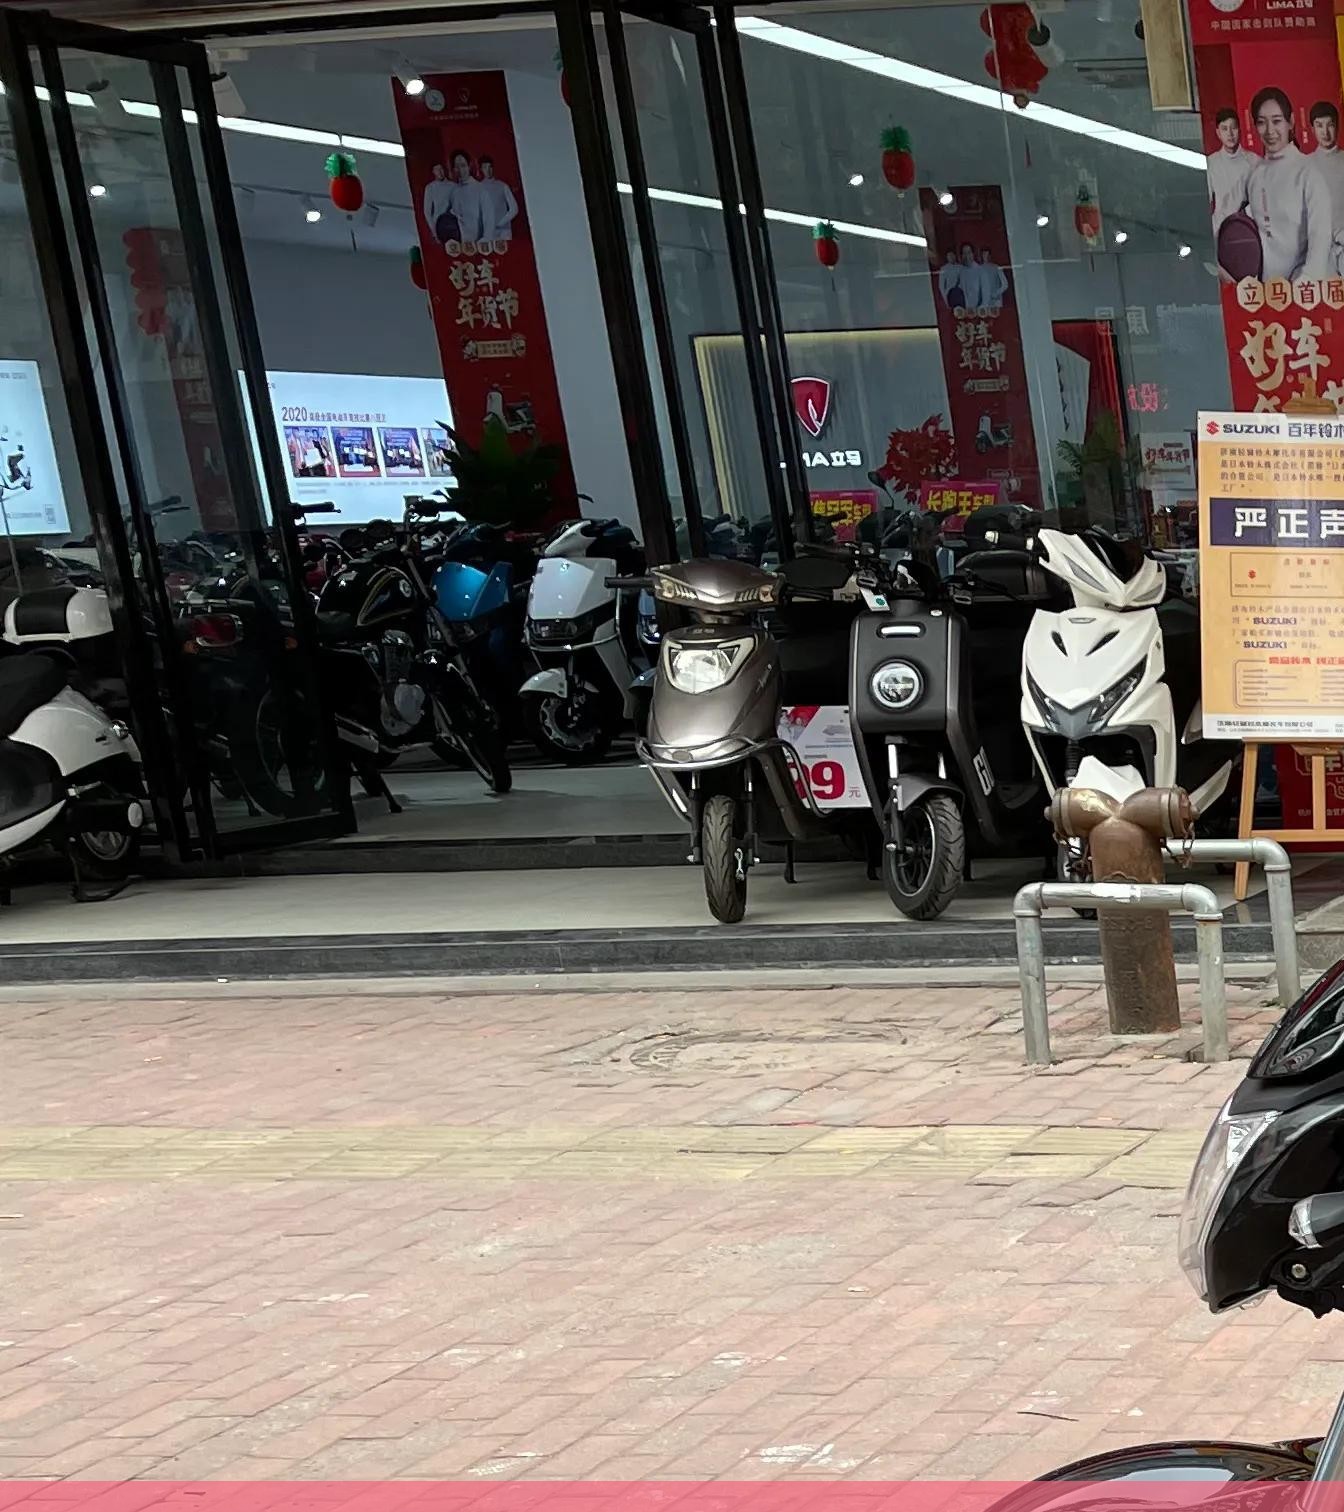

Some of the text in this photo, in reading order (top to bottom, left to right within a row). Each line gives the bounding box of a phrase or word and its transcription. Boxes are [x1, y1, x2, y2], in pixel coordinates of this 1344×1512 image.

[1243, 280, 1344, 306] 立马首届
[1239, 316, 1332, 392] 好车
[281, 406, 307, 422] 2020
[1222, 423, 1280, 435] SUZUKI
